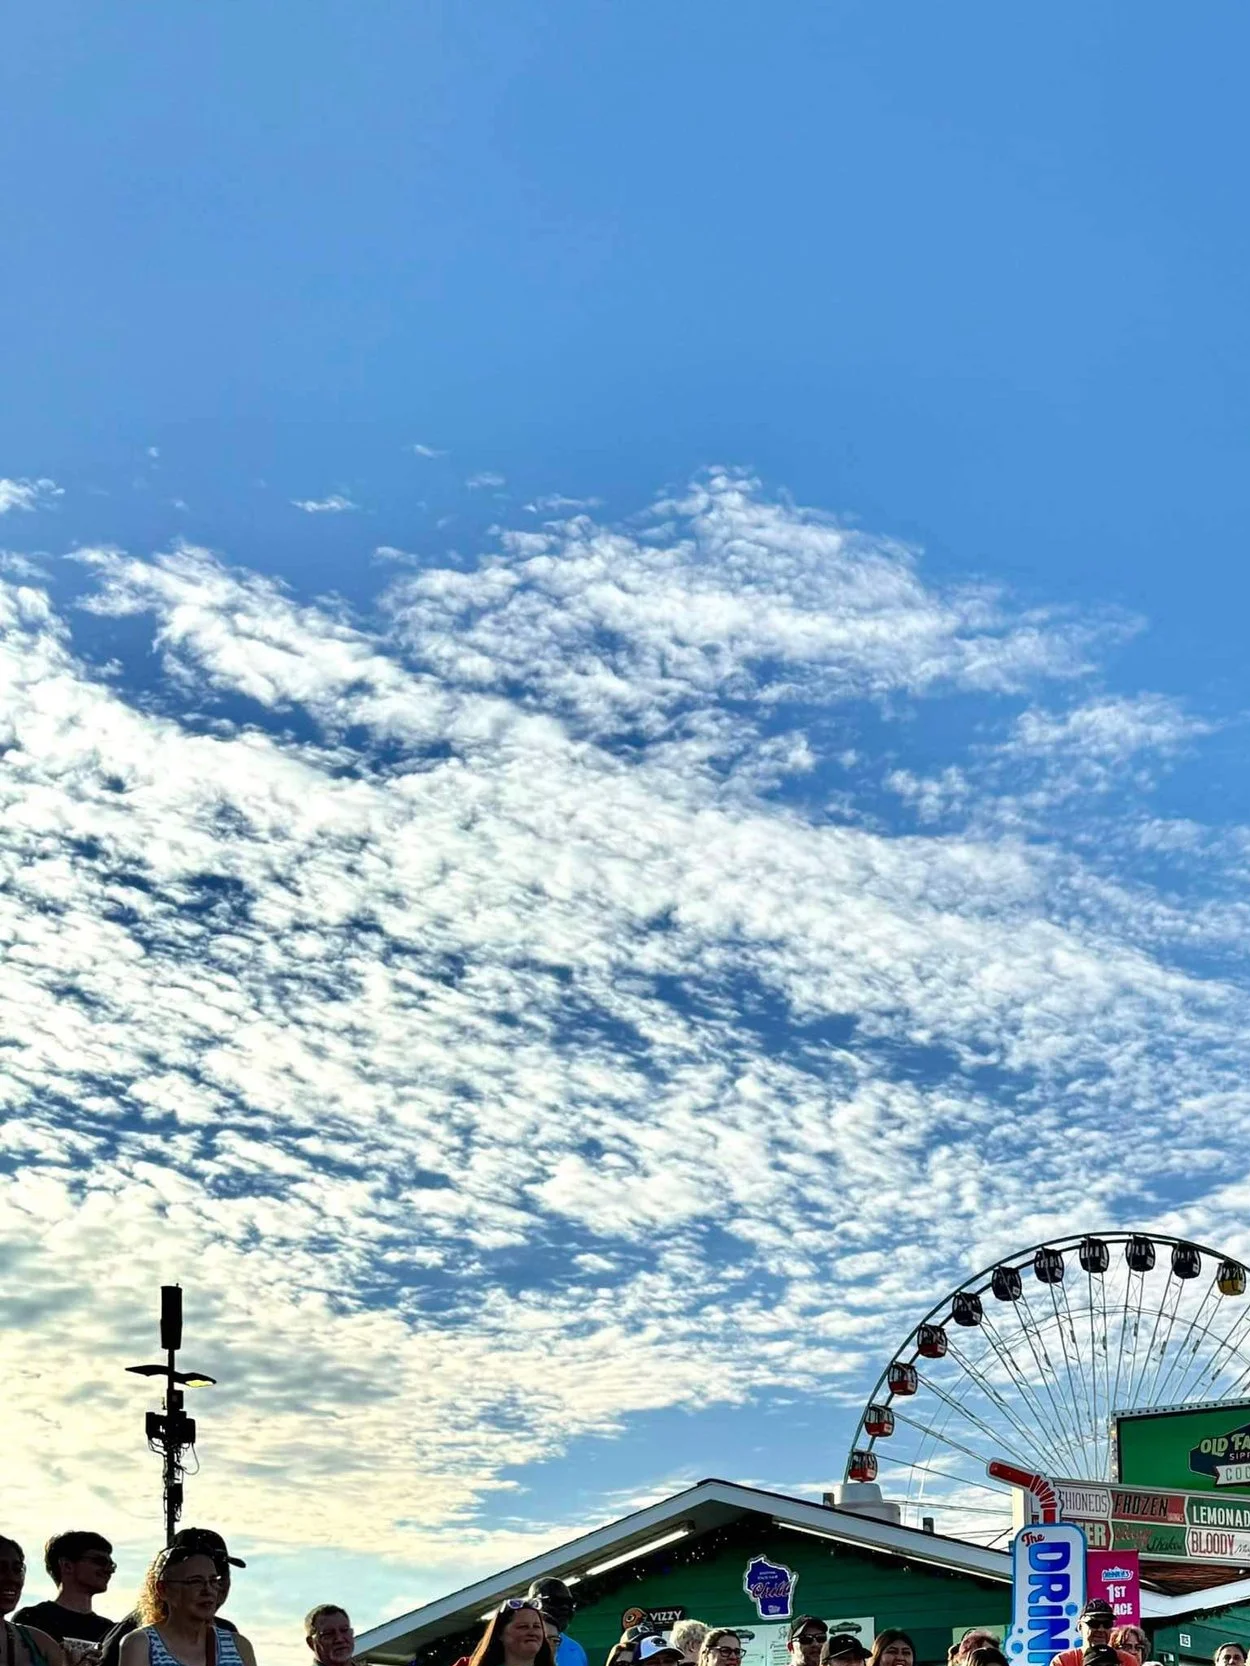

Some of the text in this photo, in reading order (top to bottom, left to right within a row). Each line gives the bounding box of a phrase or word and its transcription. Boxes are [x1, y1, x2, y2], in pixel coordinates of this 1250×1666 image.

[1200, 1437, 1229, 1457] OLD
[1060, 1490, 1107, 1513] HIONEDS
[1114, 1494, 1169, 1517] FROZEN
[1021, 1531, 1045, 1547] The
[1191, 1531, 1235, 1556] BLOODY
[1106, 1584, 1127, 1603] 1ST
[649, 1610, 682, 1622] VIZZY
